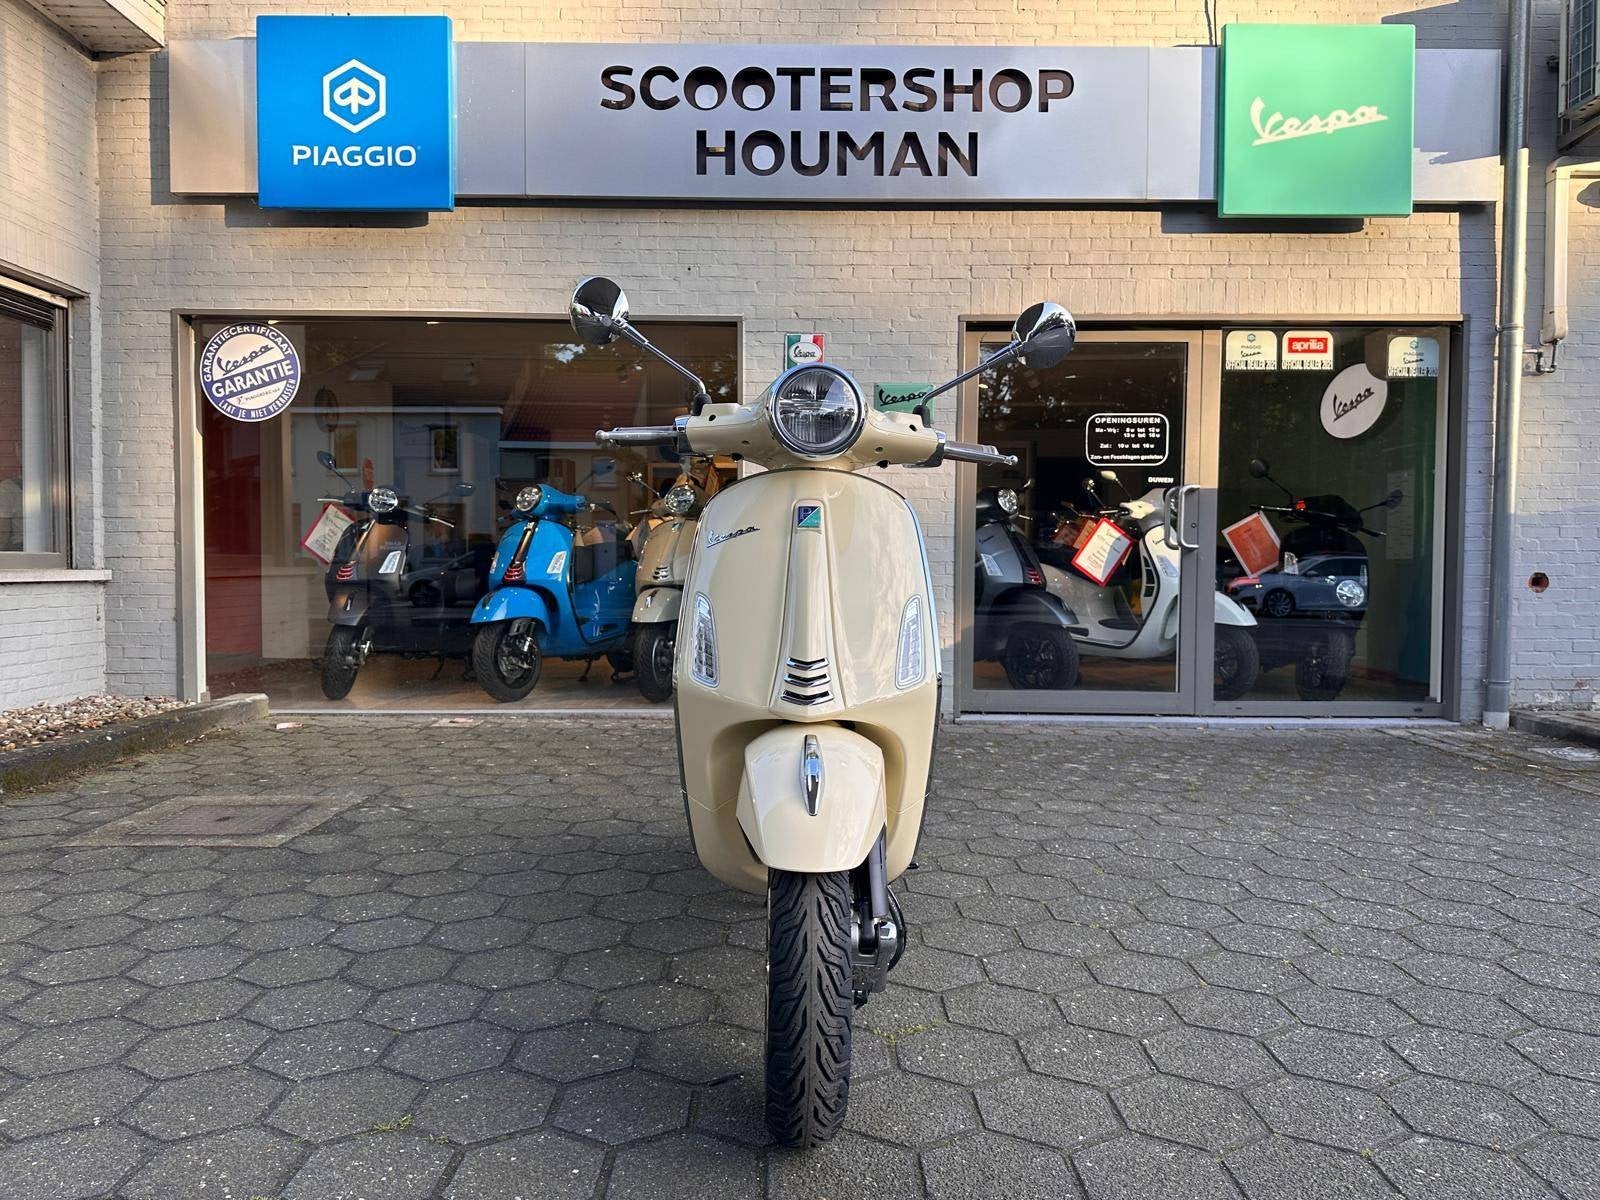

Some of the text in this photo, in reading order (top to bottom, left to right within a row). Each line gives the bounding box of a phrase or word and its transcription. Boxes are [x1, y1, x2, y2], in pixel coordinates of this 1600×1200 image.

[600, 66, 1075, 113] SCOOTERSHOP
[1250, 96, 1388, 146] Vespa
[292, 145, 417, 167] PIAGGIO
[696, 130, 979, 177] HOUMAN
[203, 325, 293, 382] GARANTIECERTIFICAAT
[217, 345, 275, 376] Vespa
[793, 345, 817, 358] Vespa
[1292, 339, 1324, 351] aprilia
[211, 360, 295, 398] GARANTIE
[219, 400, 236, 415] LAAT
[238, 410, 247, 418] JE
[251, 410, 269, 418] NIET
[270, 379, 296, 412] VERRASSEN
[878, 389, 928, 406] Vespa
[1332, 387, 1375, 422] Vespa
[706, 526, 760, 548] Vespa
